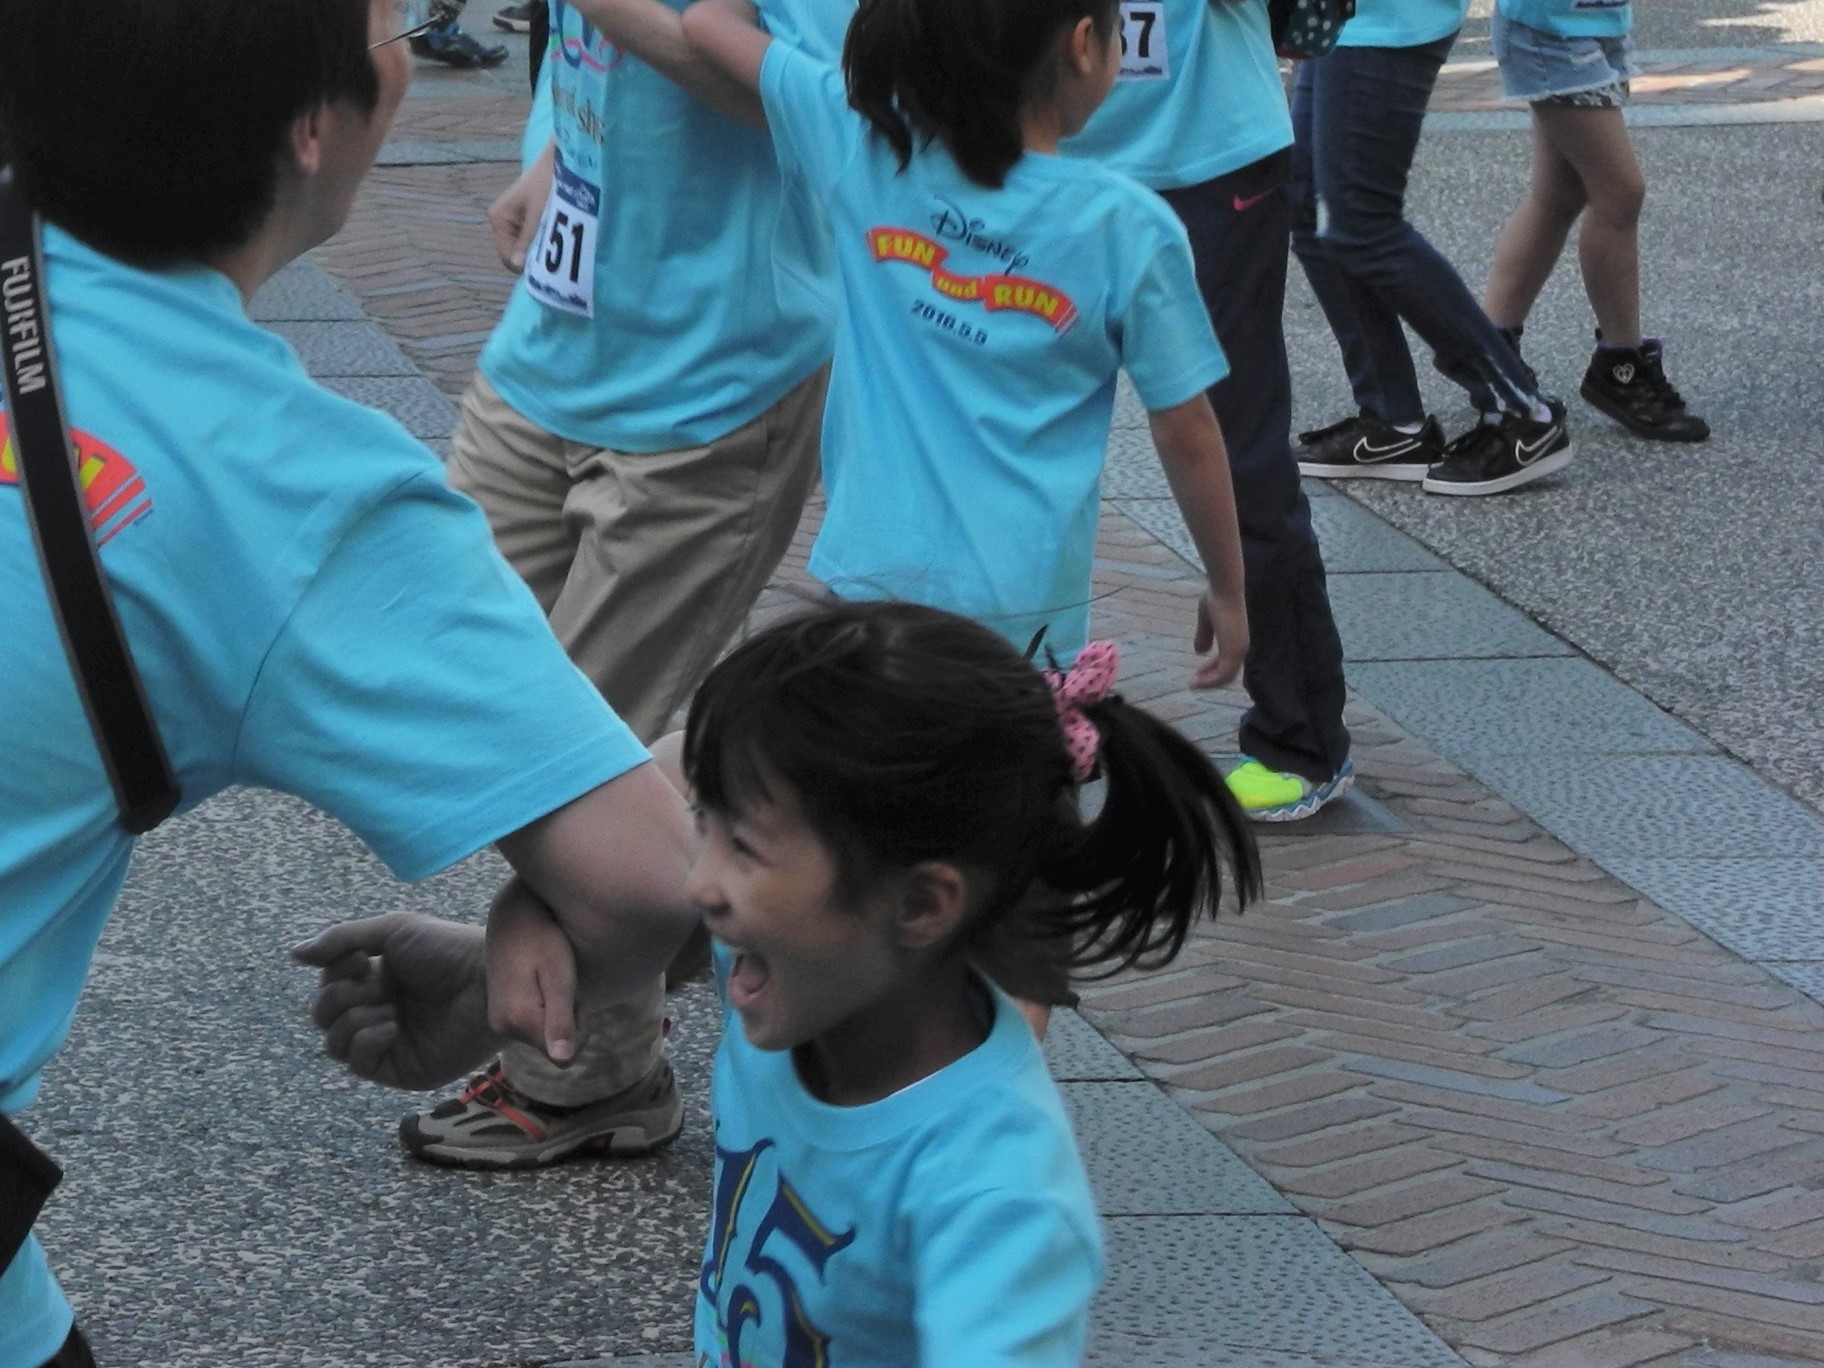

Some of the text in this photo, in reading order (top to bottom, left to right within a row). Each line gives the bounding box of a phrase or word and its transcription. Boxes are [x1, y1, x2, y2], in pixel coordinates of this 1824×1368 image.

[876, 233, 938, 267] FUN
[993, 282, 1061, 319] RUN
[929, 193, 1030, 277] Disney
[0, 255, 47, 395] FUJIFILM
